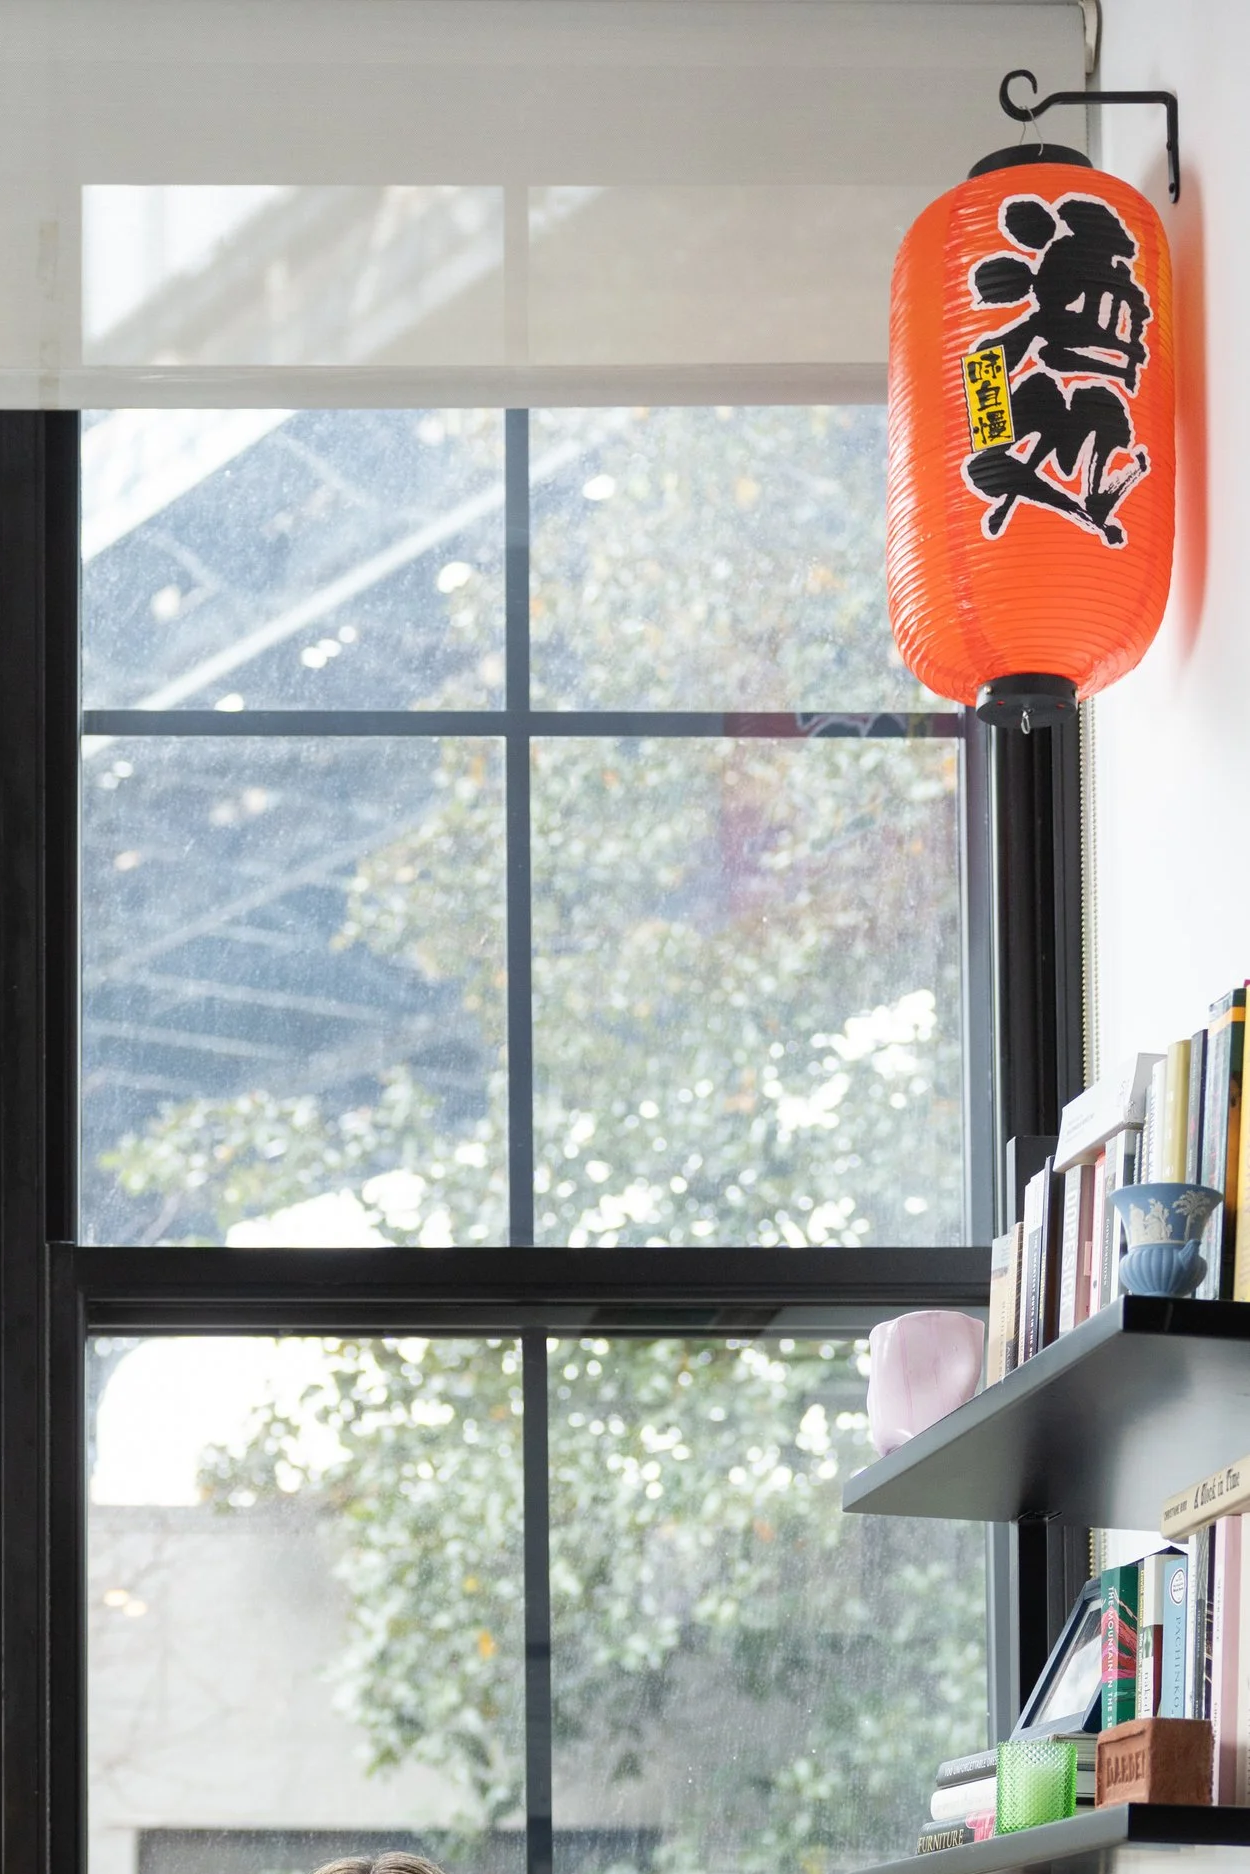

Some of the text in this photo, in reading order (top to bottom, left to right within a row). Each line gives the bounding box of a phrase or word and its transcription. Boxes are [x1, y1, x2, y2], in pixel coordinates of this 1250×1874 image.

[967, 350, 1013, 445] 味自慢
[1062, 1188, 1078, 1310] DOPESICK
[1103, 1217, 1111, 1288] CONFESSIONS
[1107, 1586, 1115, 1607] THE
[1106, 1610, 1114, 1672] MOUNTAIN
[1173, 1616, 1182, 1709] PACHINKO
[1106, 1676, 1114, 1688] IN
[917, 1828, 965, 1854] FURNITURE
